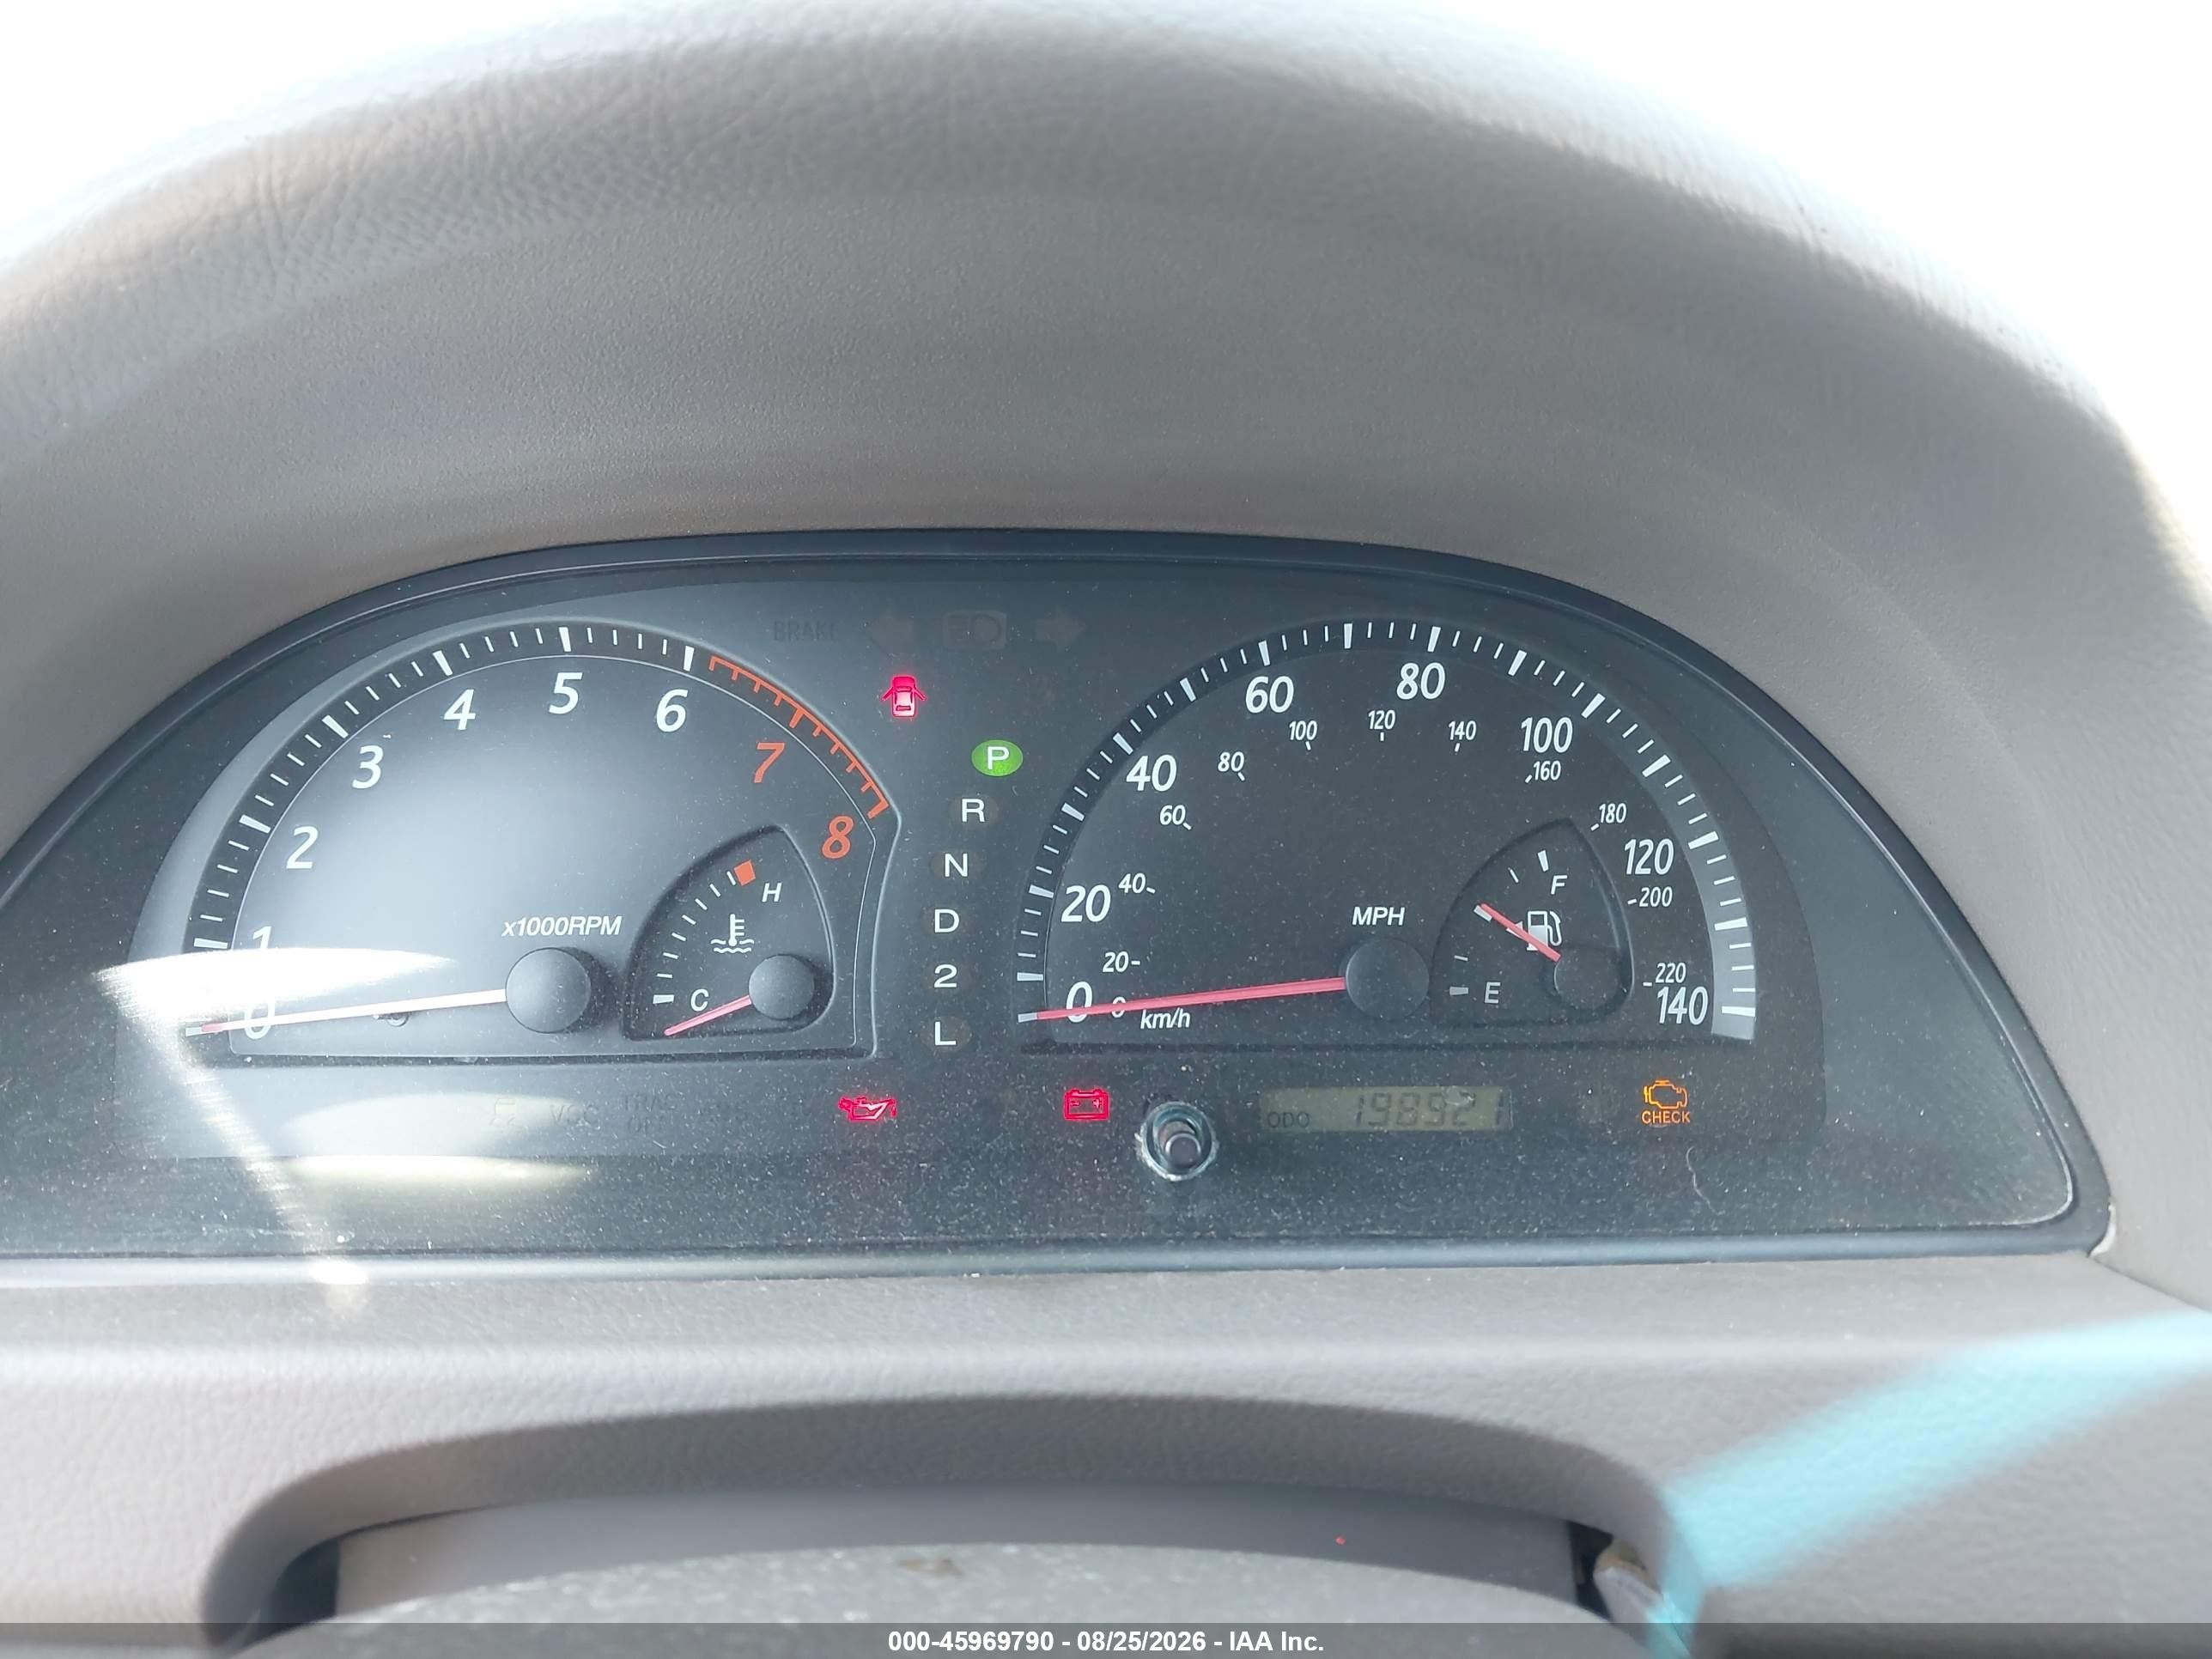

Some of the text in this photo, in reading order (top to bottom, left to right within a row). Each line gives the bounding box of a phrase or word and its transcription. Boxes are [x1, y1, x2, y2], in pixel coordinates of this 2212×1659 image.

[1396, 662, 1446, 700] 80
[548, 672, 583, 715] 5
[1245, 675, 1295, 714] 60
[443, 689, 477, 731] 4
[654, 689, 689, 732] 6
[1367, 709, 1396, 731] 120
[1288, 720, 1318, 742] 100
[1448, 720, 1477, 742] 140
[1521, 716, 1574, 754] 100
[351, 744, 384, 789] 3
[752, 741, 785, 784] 7
[987, 746, 1010, 770] P
[1217, 751, 1245, 773] 80
[1126, 754, 1177, 792] 40
[1532, 760, 1562, 781] 160
[961, 799, 986, 823] R
[1159, 805, 1186, 826] 60
[1598, 804, 1627, 824] 180
[285, 825, 319, 870] 2
[821, 815, 854, 860] 8
[944, 854, 969, 878] N
[1624, 838, 1674, 876] 120
[762, 883, 781, 902] H
[1118, 872, 1147, 894] 40
[1551, 875, 1568, 894] F
[1060, 884, 1112, 923] 20
[1638, 887, 1674, 908] 200
[501, 915, 622, 937] x1000RPM
[933, 908, 960, 933] D
[1351, 906, 1406, 927] MPH
[1102, 951, 1129, 973] 20
[1656, 963, 1686, 983] 220
[933, 965, 957, 989] 2
[690, 988, 709, 1011] C
[1065, 981, 1093, 1024] 0
[1484, 981, 1501, 1004] E
[1656, 987, 1709, 1025] 140
[244, 999, 276, 1040] 0
[1139, 1008, 1191, 1030] km/h
[933, 1021, 957, 1047] L
[1267, 1111, 1310, 1130] ODO
[1355, 1091, 1504, 1127] 198921
[1641, 1110, 1691, 1124] CHECK
